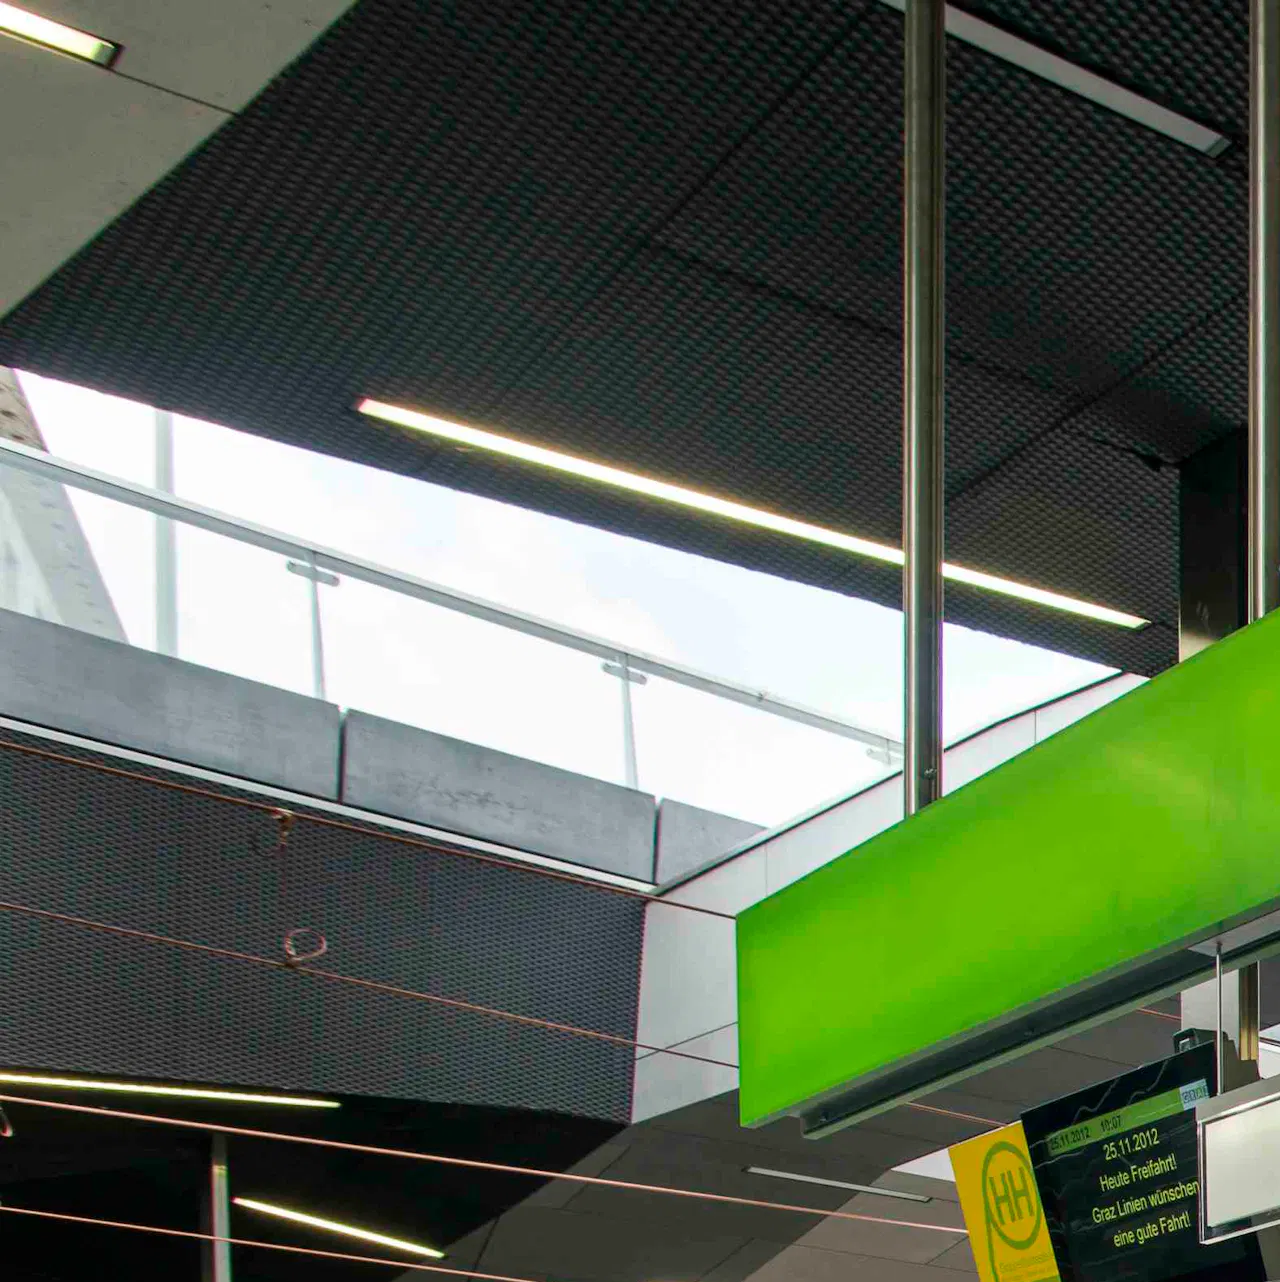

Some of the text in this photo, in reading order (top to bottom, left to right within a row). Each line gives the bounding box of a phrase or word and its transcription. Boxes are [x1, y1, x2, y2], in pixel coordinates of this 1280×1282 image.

[1103, 1127, 1160, 1161] 25.11.2012
[1100, 1152, 1178, 1193] Heute Freifahrt!
[1092, 1180, 1200, 1225] Graz Linien wünschen
[1113, 1210, 1192, 1248] eine gute Fahrt!
